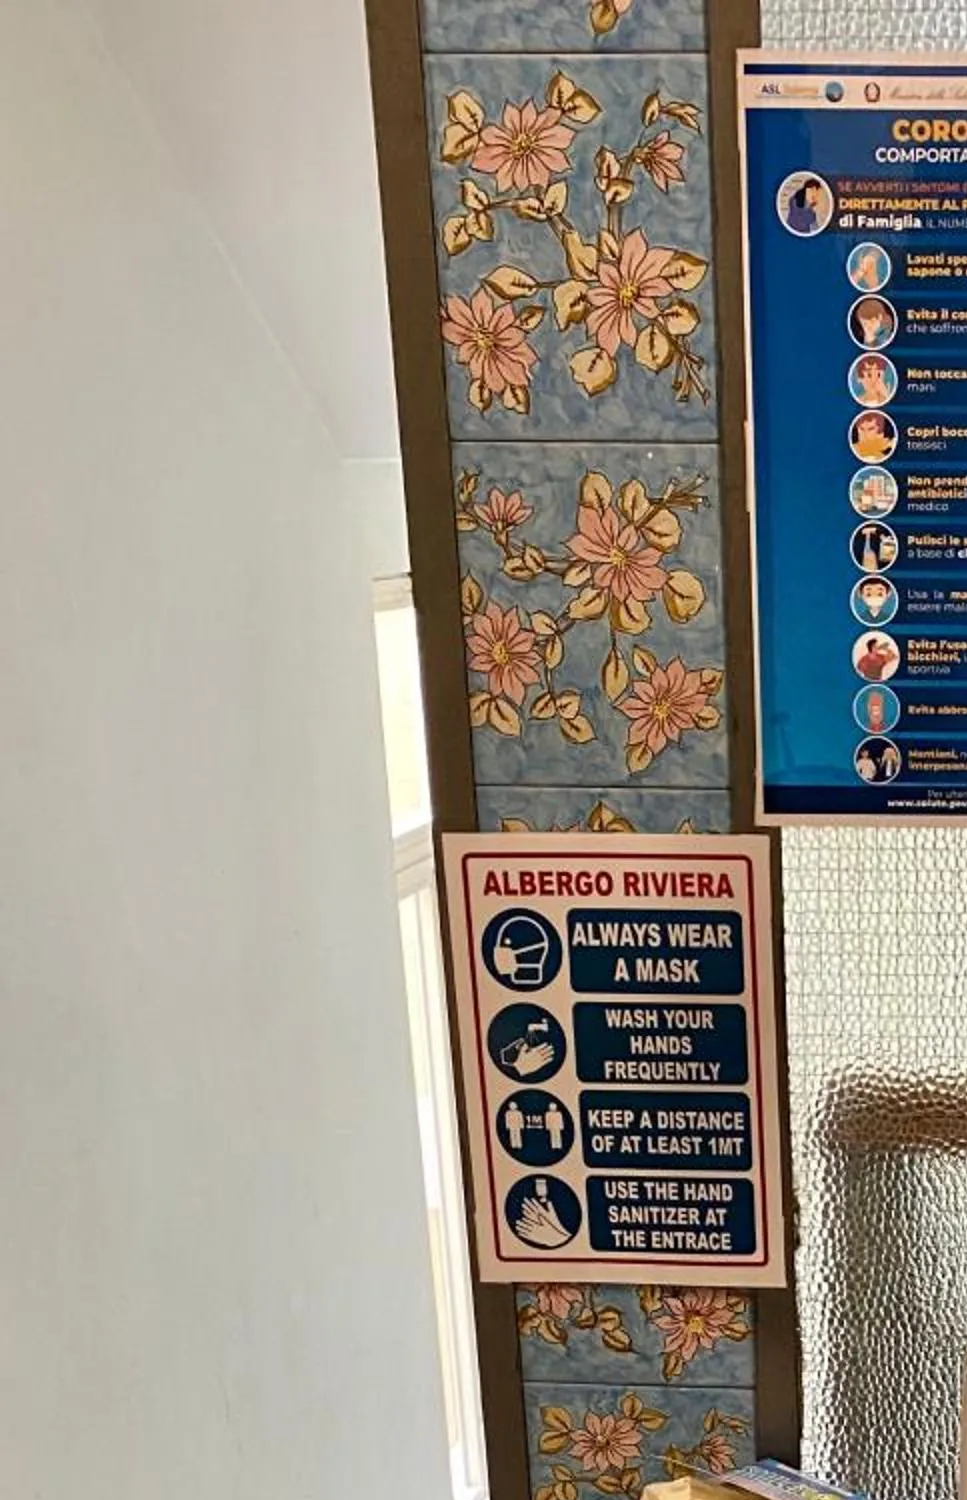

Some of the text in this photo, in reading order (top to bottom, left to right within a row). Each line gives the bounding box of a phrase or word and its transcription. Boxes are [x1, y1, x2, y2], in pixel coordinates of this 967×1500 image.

[840, 198, 939, 210] DIRETTAMENTE
[942, 199, 960, 210] AL
[839, 215, 853, 227] di
[858, 215, 921, 230] Famiglia
[907, 254, 944, 264] Lavati
[907, 267, 950, 278] sapone
[907, 310, 936, 320] Evita
[906, 324, 926, 333] che
[907, 369, 932, 379] Non
[908, 427, 940, 439] Copri
[908, 477, 930, 486] Non
[908, 489, 967, 498] antibiotici
[908, 501, 948, 511] medico
[908, 536, 947, 546] Pulisci
[950, 536, 960, 546] le
[908, 640, 936, 649] Evita
[908, 652, 961, 663] bicchieri,
[908, 705, 935, 714] Evita
[483, 870, 735, 898] ALBERGO RIVIERA
[572, 923, 732, 948] ALWAYS WEAR
[615, 958, 700, 983] A MASK
[605, 1009, 714, 1029] WASH YOUR
[630, 1035, 693, 1055] HANDS
[604, 1060, 721, 1081] FREQUENTLY
[588, 1110, 745, 1131] KEEP A DISTANCE
[591, 1135, 745, 1157] OF AT LEAST 1MT
[604, 1180, 733, 1202] USE THE HAND
[609, 1205, 727, 1226] SANITIZER AT
[611, 1229, 732, 1251] THE ENTRACE
